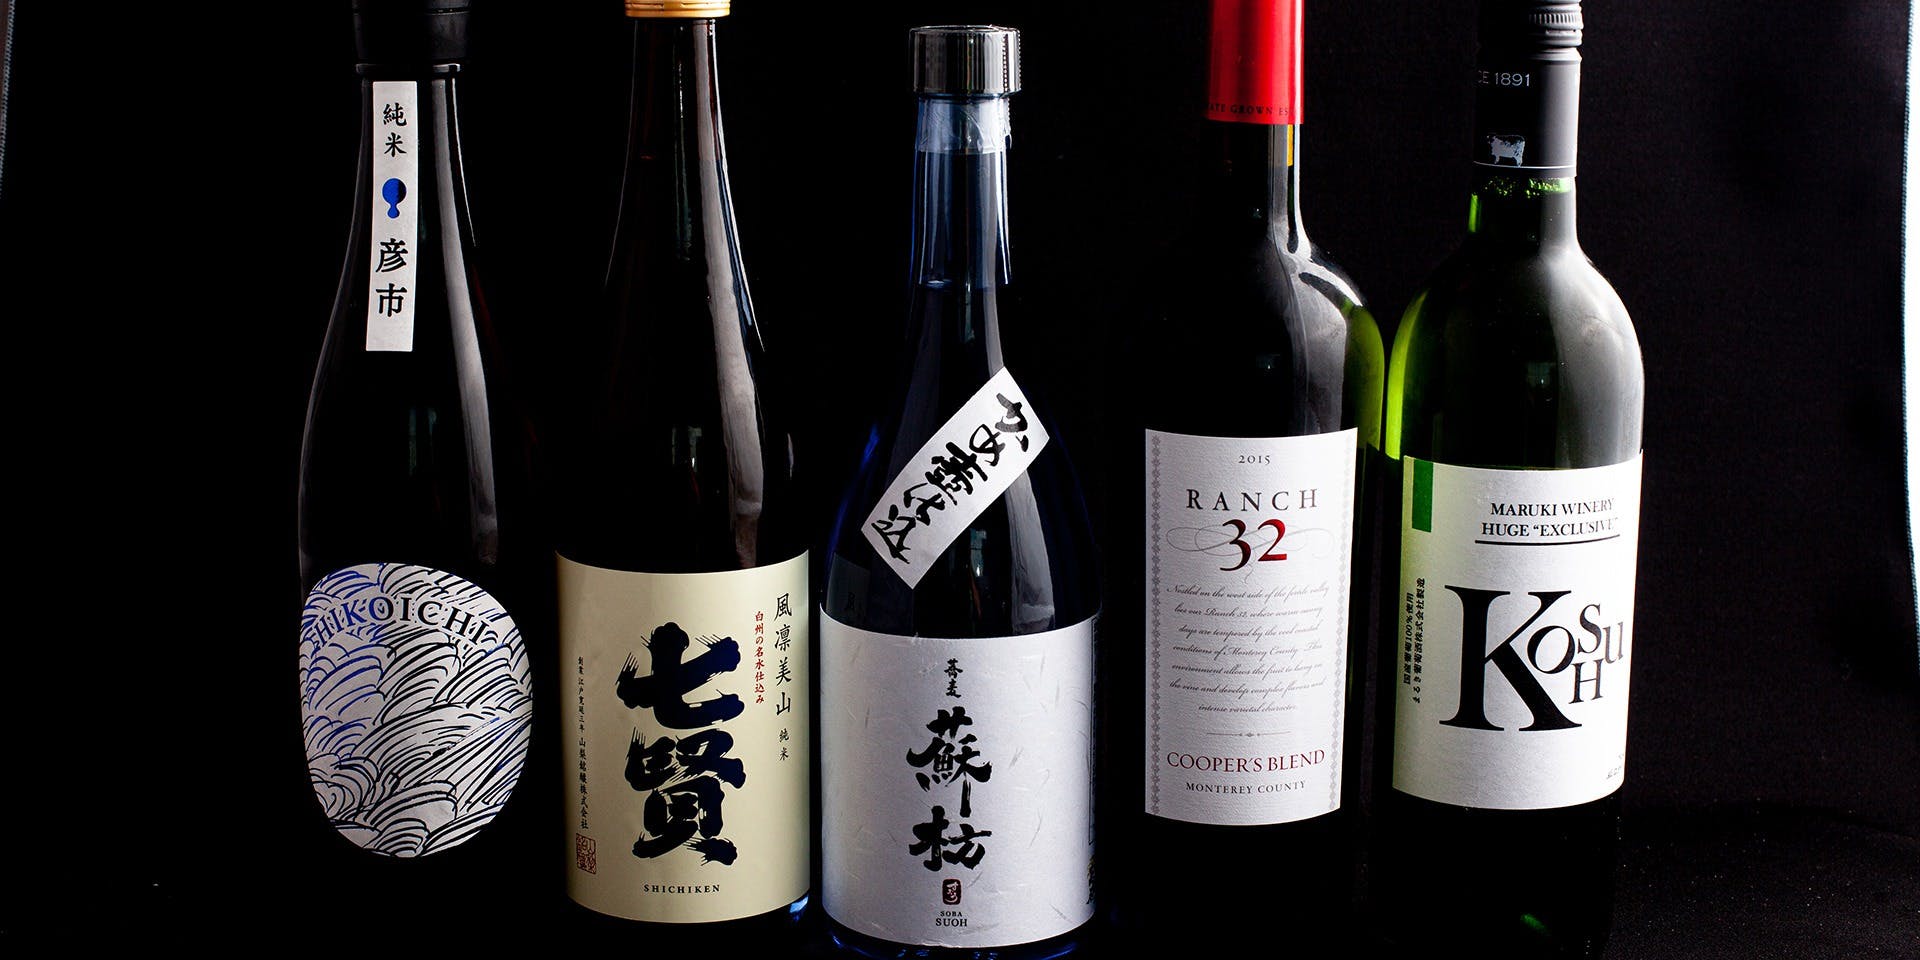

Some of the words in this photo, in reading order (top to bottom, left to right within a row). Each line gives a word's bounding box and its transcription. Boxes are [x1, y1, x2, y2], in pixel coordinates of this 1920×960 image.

[1494, 72, 1531, 87] 1891
[1230, 104, 1273, 115] GROWN
[382, 102, 408, 158] 純米
[375, 237, 409, 318] 彦市
[1238, 454, 1271, 465] 2015
[1186, 488, 1318, 511] RANCH
[1490, 502, 1557, 516] MARUKI
[1561, 497, 1615, 515] WINERY
[1481, 522, 1530, 537] HUGE
[1219, 518, 1288, 571] 32
[1212, 586, 1226, 598] the
[1247, 588, 1263, 599] side
[1264, 585, 1280, 604] of
[1273, 585, 1288, 598] the
[1204, 606, 1239, 617] Ranch
[1249, 606, 1274, 617] where
[314, 596, 490, 647] HIKOICHI
[1178, 624, 1198, 639] days
[1213, 626, 1254, 642] tempered
[1252, 625, 1264, 643] by
[1265, 625, 1279, 636] the
[754, 611, 765, 704] 白州の名水仕込み
[1172, 644, 1213, 654] conditions
[1213, 644, 1229, 661] of
[1223, 646, 1267, 662] Monterey
[1171, 663, 1223, 674] environment
[1223, 663, 1250, 675] allows
[1252, 663, 1266, 675] the
[1261, 663, 1285, 681] fruit
[1169, 677, 1182, 688] the
[1200, 683, 1221, 692] and
[1218, 682, 1249, 700] develop
[1250, 681, 1285, 699] complex
[1198, 703, 1228, 712] intense
[1229, 702, 1266, 712] varietal
[614, 620, 747, 867] 七賢
[779, 727, 790, 761] 純米
[1166, 751, 1263, 773] COOPER'S
[1268, 749, 1325, 772] BLEND
[1185, 782, 1253, 794] MONTEREY
[1257, 780, 1306, 794] COUNTY
[643, 884, 720, 894] SHICHIKEN
[935, 917, 968, 927] SUOH
[939, 910, 963, 918] SOBA
